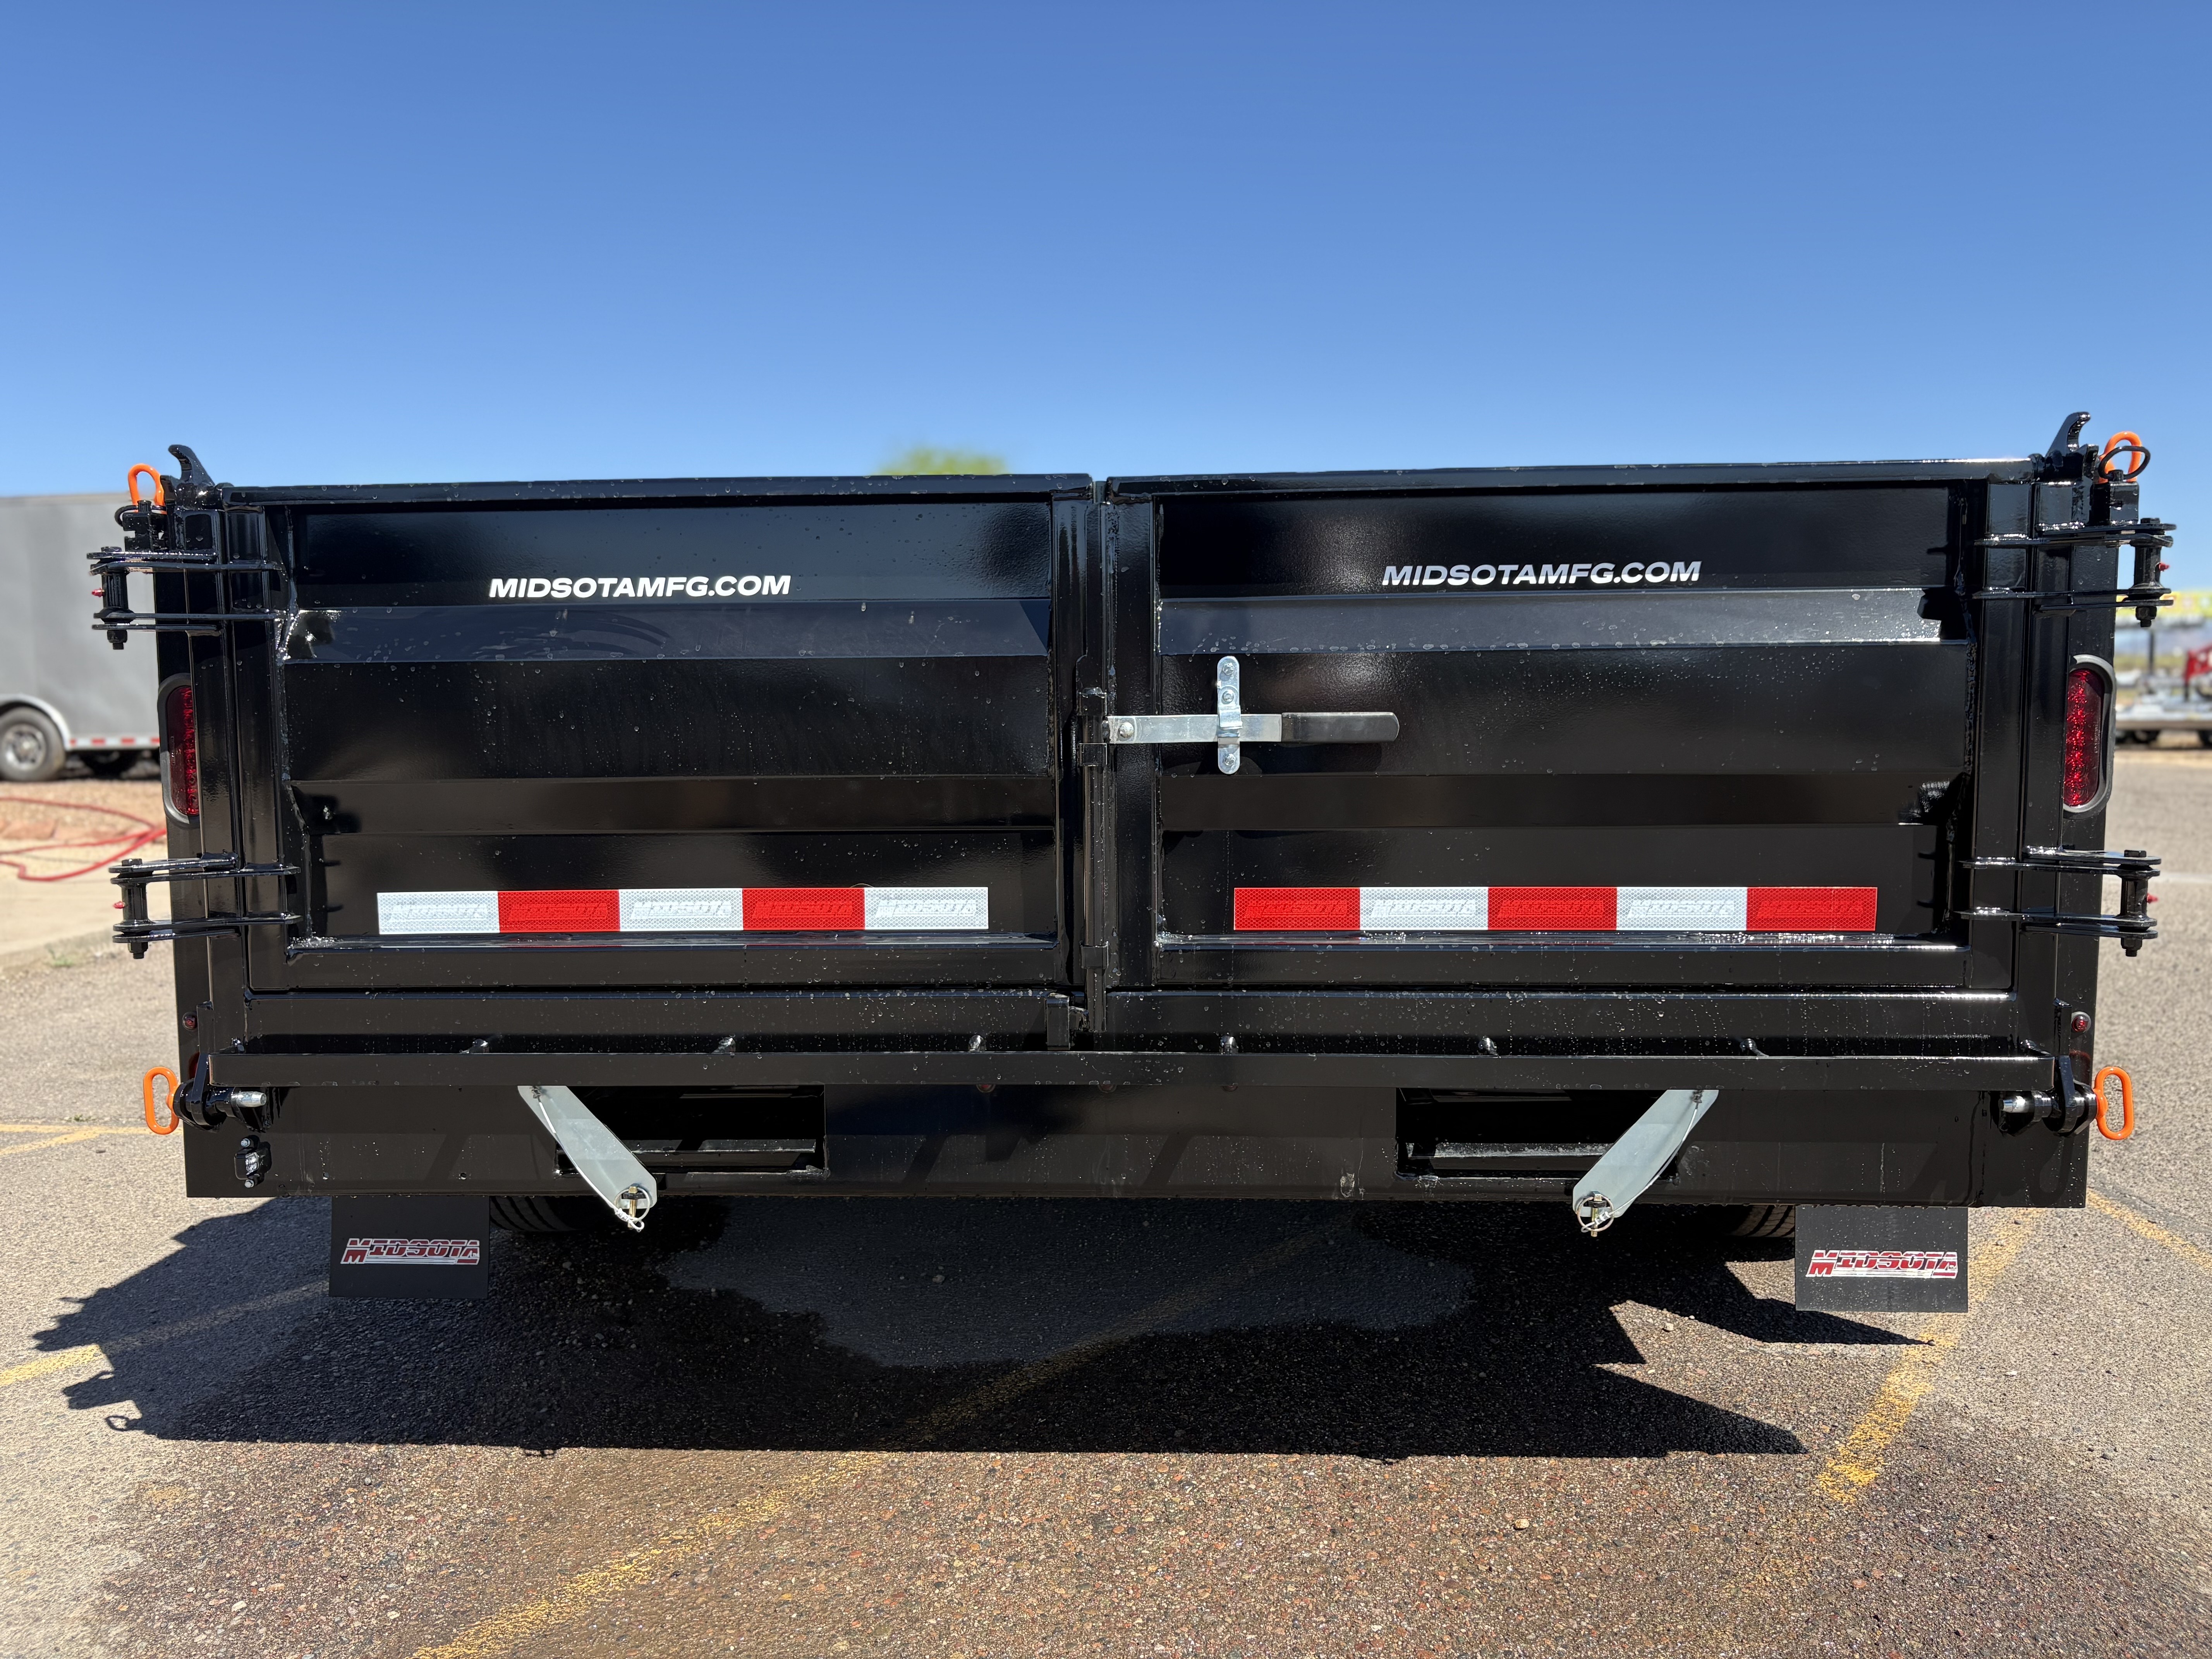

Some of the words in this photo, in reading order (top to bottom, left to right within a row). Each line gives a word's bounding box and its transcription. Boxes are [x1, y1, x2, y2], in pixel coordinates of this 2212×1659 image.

[489, 575, 791, 598] MIDSOTAMFG.COM
[1382, 561, 1701, 586] MIDSOTAMFG.COM
[340, 1238, 480, 1265] MIDSOTA
[1805, 1250, 1958, 1279] MIDSOTA
